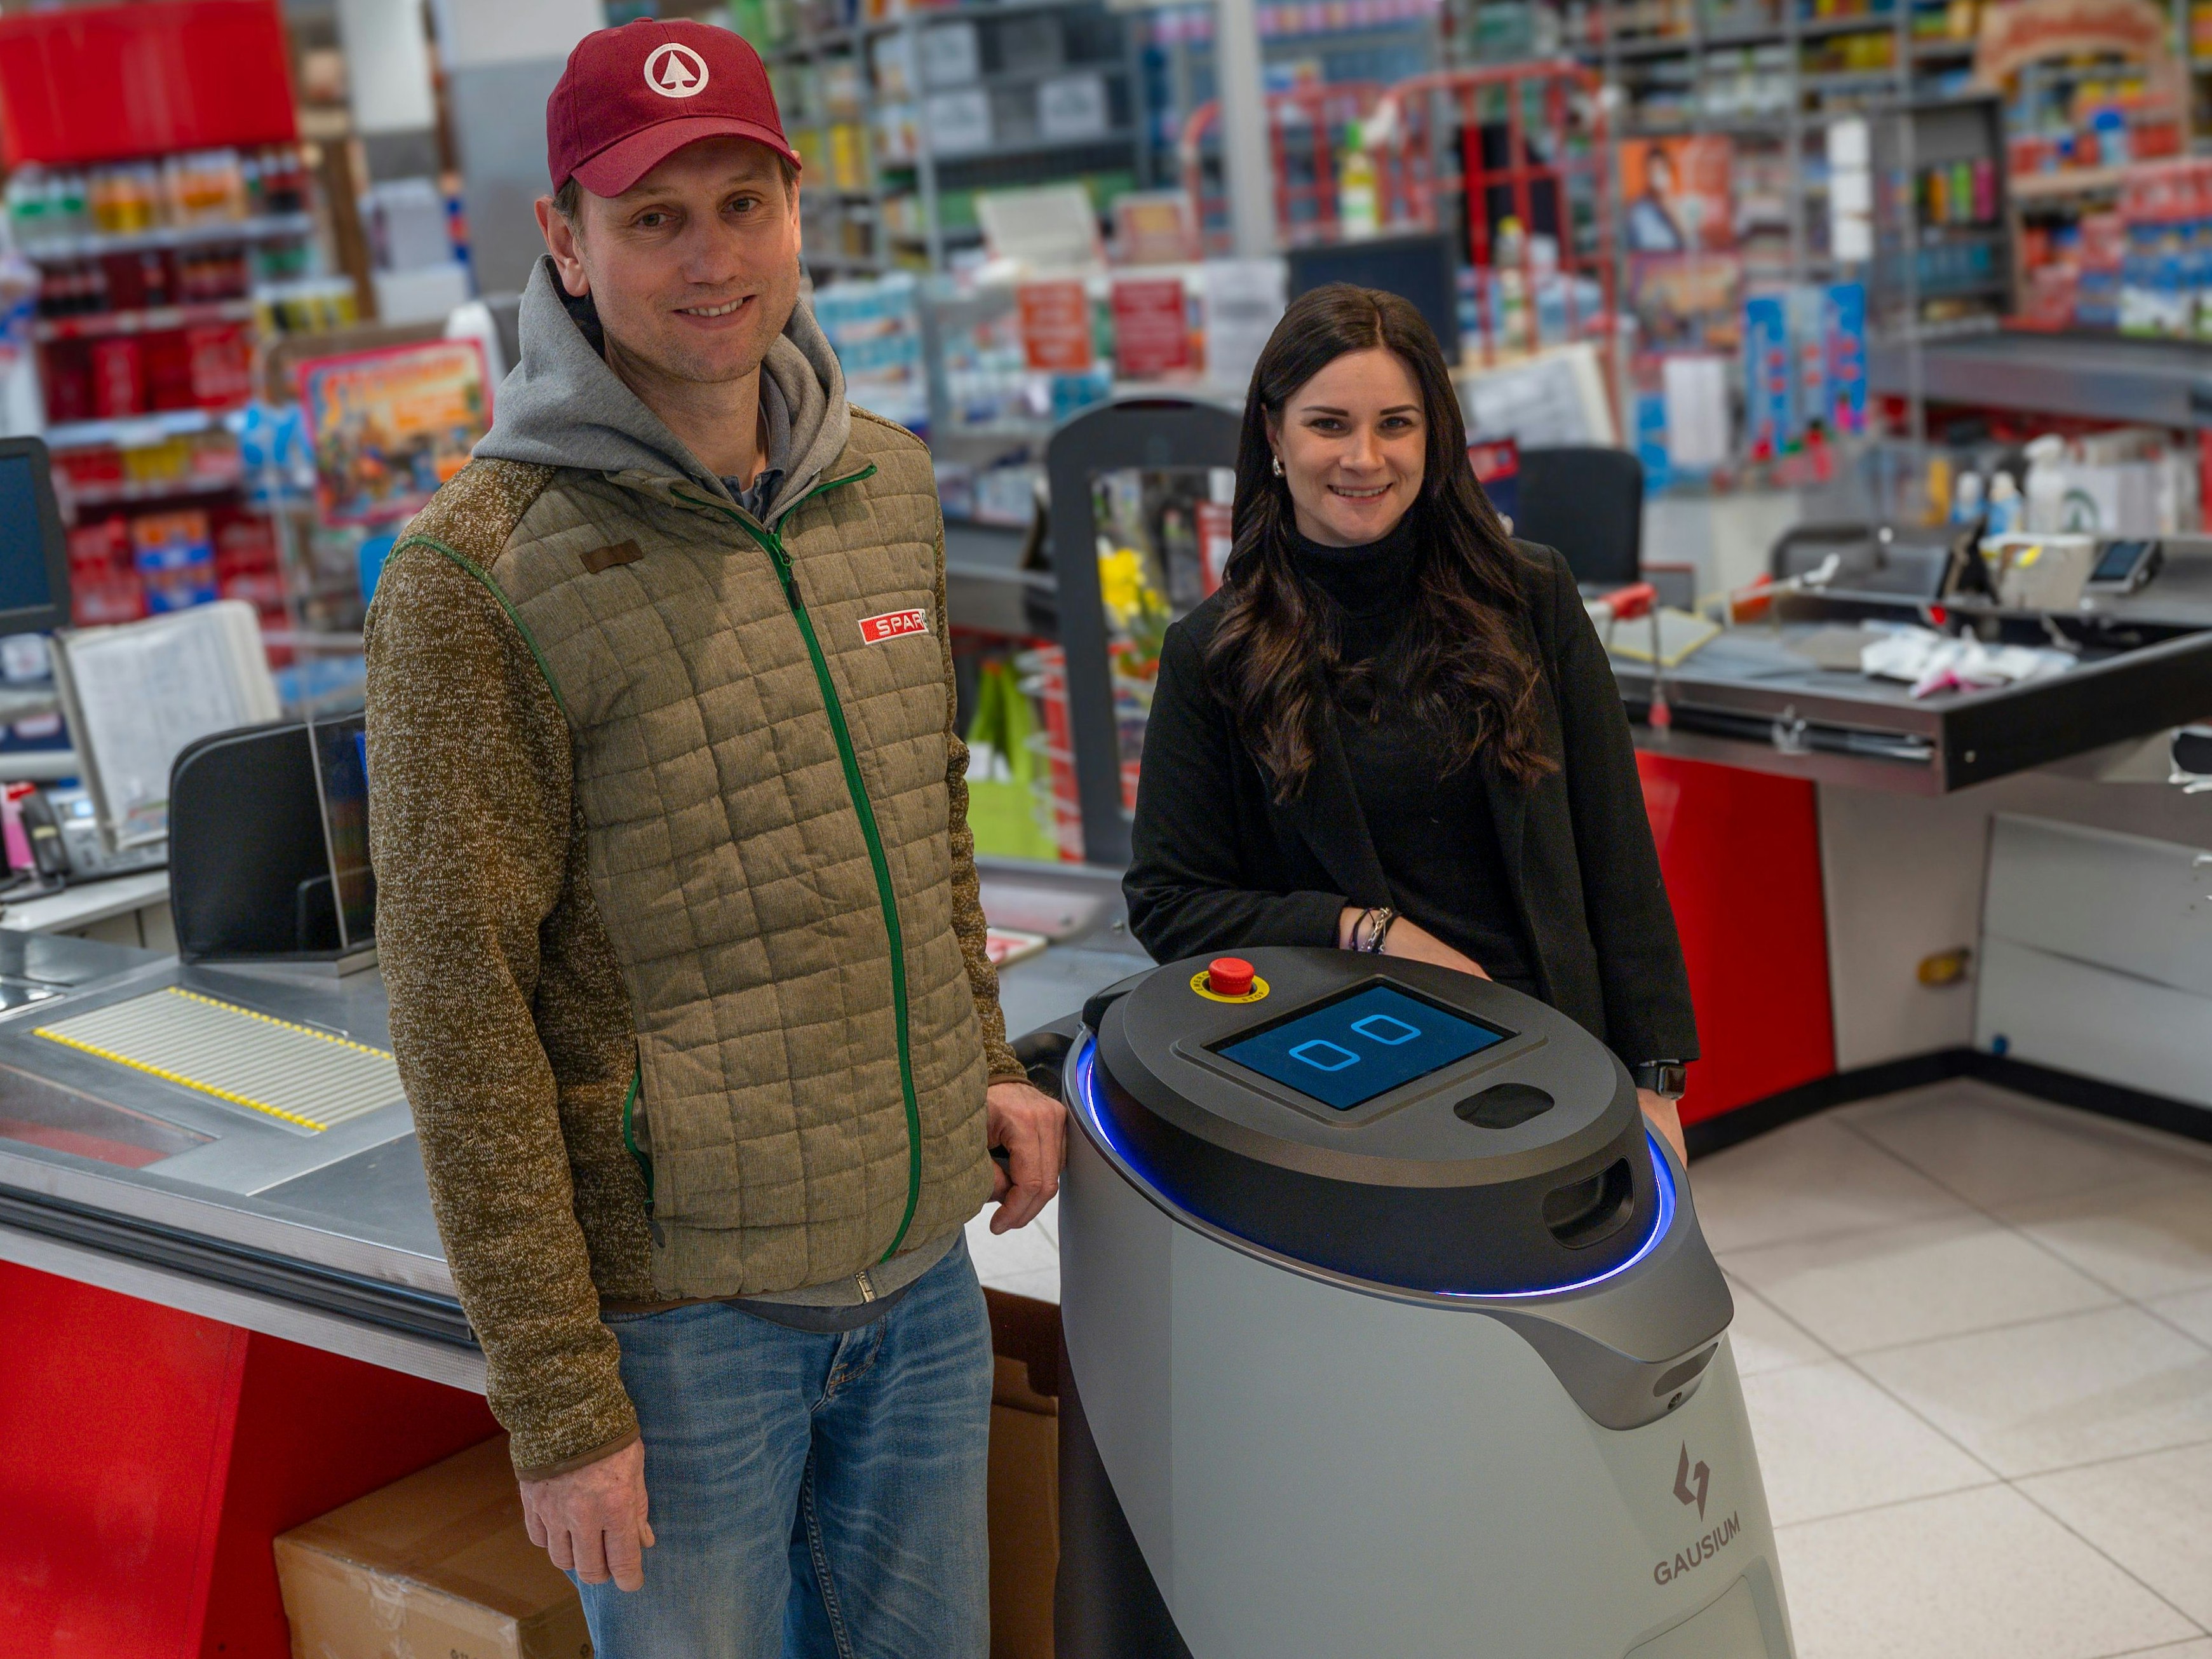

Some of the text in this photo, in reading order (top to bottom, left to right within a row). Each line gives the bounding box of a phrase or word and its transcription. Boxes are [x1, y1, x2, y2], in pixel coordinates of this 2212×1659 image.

[876, 613, 924, 635] SPAR
[1241, 991, 1264, 1002] STOP
[1654, 1510, 1741, 1585] GAUSIUM
